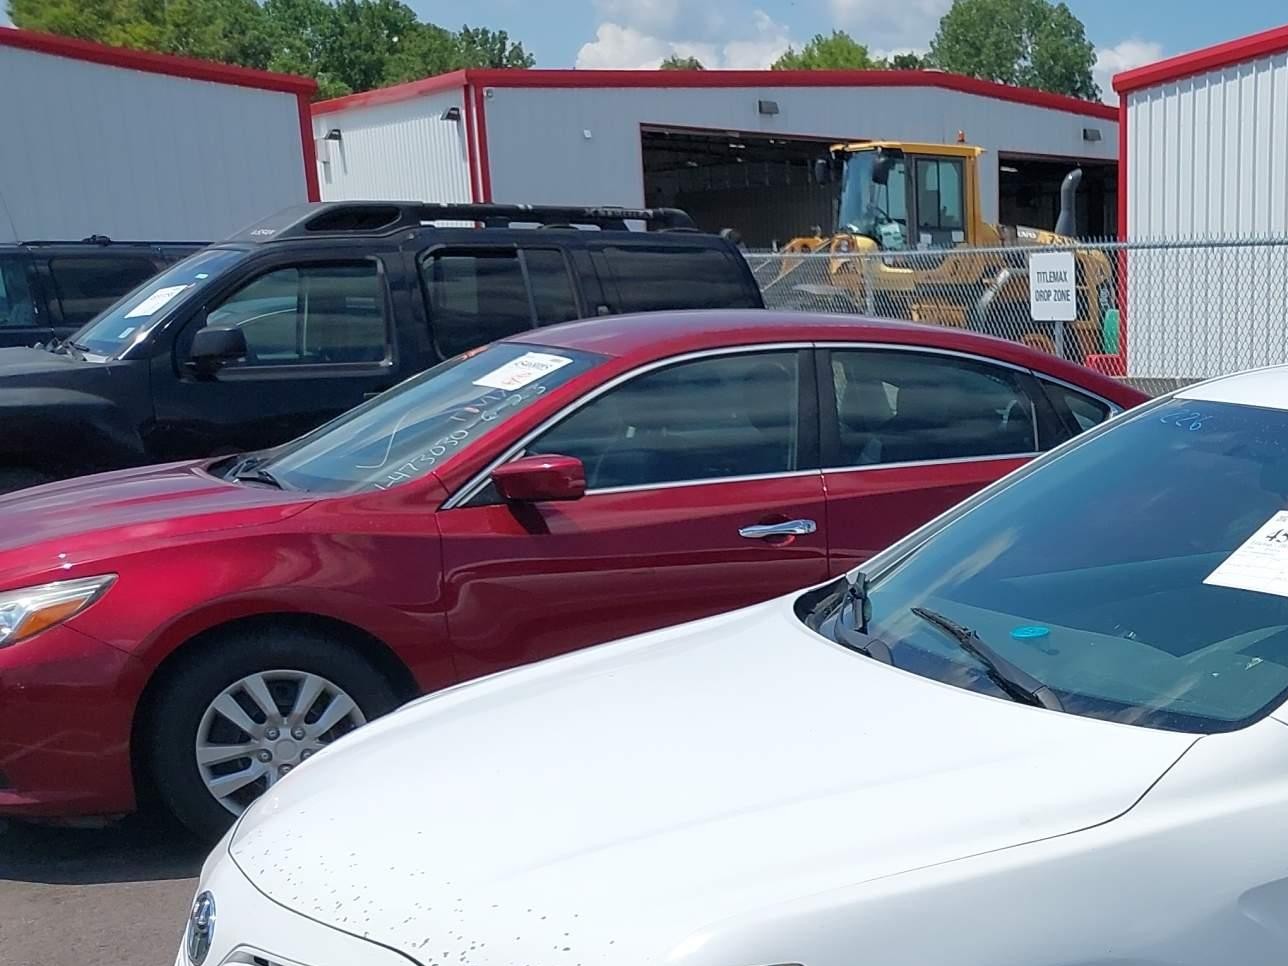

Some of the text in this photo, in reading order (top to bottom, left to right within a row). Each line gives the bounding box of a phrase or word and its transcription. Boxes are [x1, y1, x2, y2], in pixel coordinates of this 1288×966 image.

[1036, 271, 1068, 283] TITLEMAX
[1034, 289, 1071, 302] DROP ZONE
